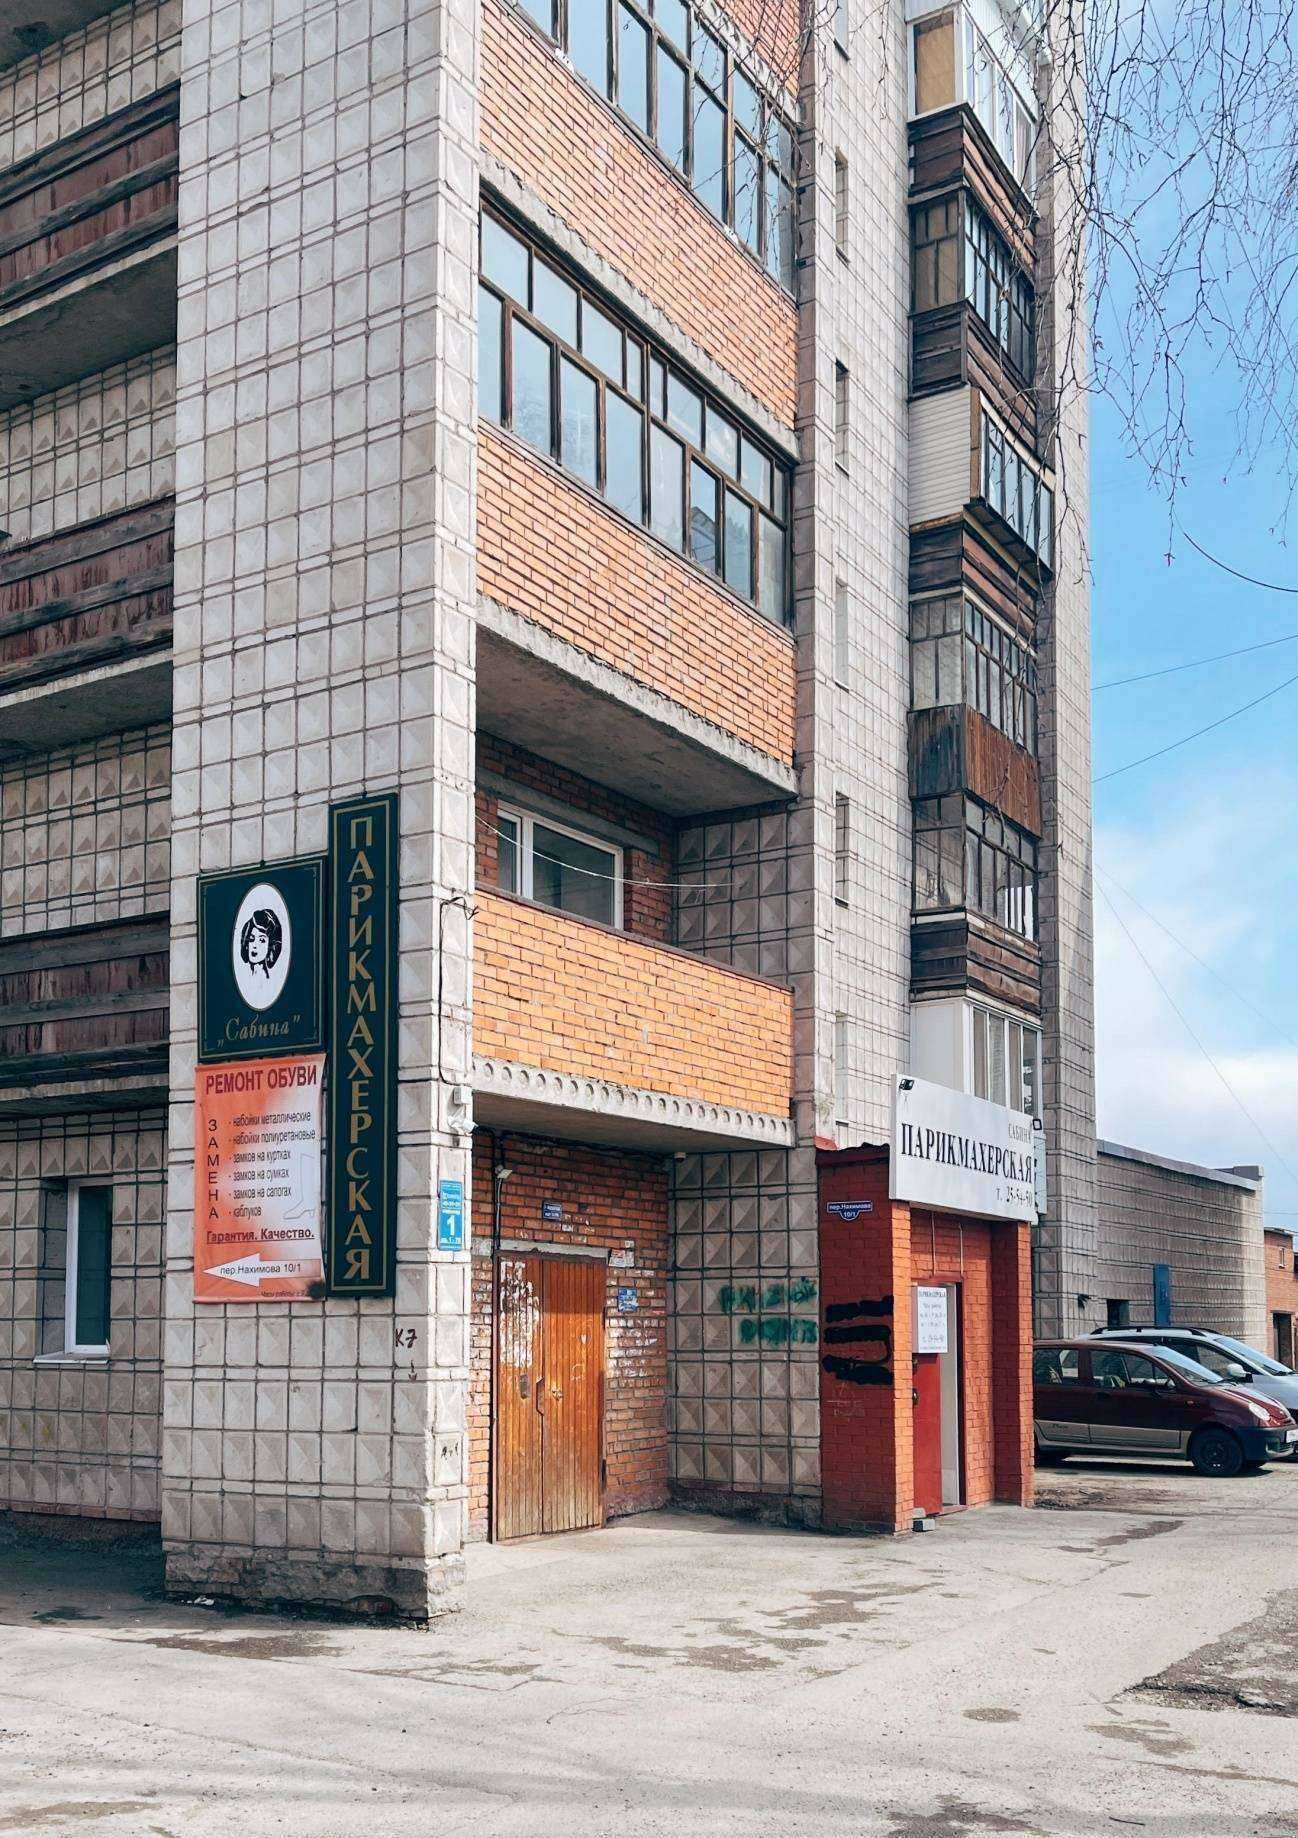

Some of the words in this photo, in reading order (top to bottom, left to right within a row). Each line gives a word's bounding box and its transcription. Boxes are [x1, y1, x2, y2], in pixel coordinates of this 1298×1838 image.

[346, 815, 376, 1280] ПАРИКМАХЕРСКАЯ
[206, 1070, 262, 1095] РЕМОНТ
[267, 1065, 317, 1089] ОБУВИ
[233, 1114, 260, 1127] набойки
[233, 1132, 260, 1145] набойки
[233, 1153, 256, 1163] замков
[257, 1152, 265, 1161] на
[266, 1150, 291, 1164] куртках
[901, 1123, 1032, 1183] ПАРИКМАХЕРСКАЯ
[207, 1119, 220, 1219] ЗАМЕНА
[233, 1171, 256, 1181] замков
[257, 1170, 265, 1180] на
[266, 1168, 290, 1182] сумках
[233, 1189, 256, 1199] замков
[257, 1188, 265, 1198] на
[266, 1187, 292, 1197] сапогах
[206, 1231, 258, 1243] Гарантия.
[261, 1228, 315, 1240] Качество.
[284, 1263, 302, 1273] 10/1
